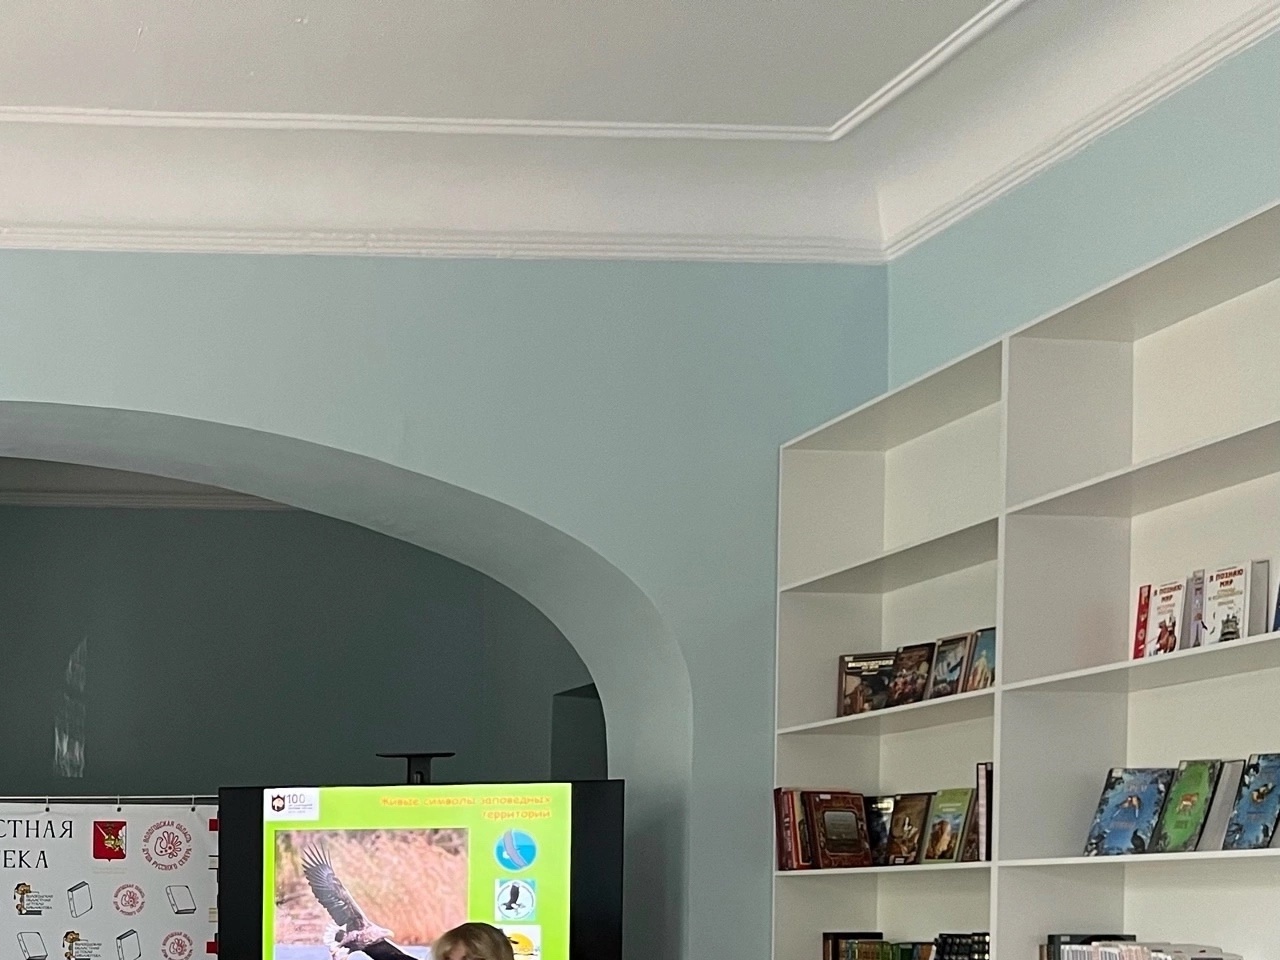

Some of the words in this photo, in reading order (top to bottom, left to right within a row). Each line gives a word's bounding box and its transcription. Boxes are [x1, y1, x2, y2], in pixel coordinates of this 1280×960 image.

[286, 793, 306, 804] 100
[380, 796, 420, 808] Живые
[423, 796, 476, 807] символы
[480, 795, 551, 807] заповедных
